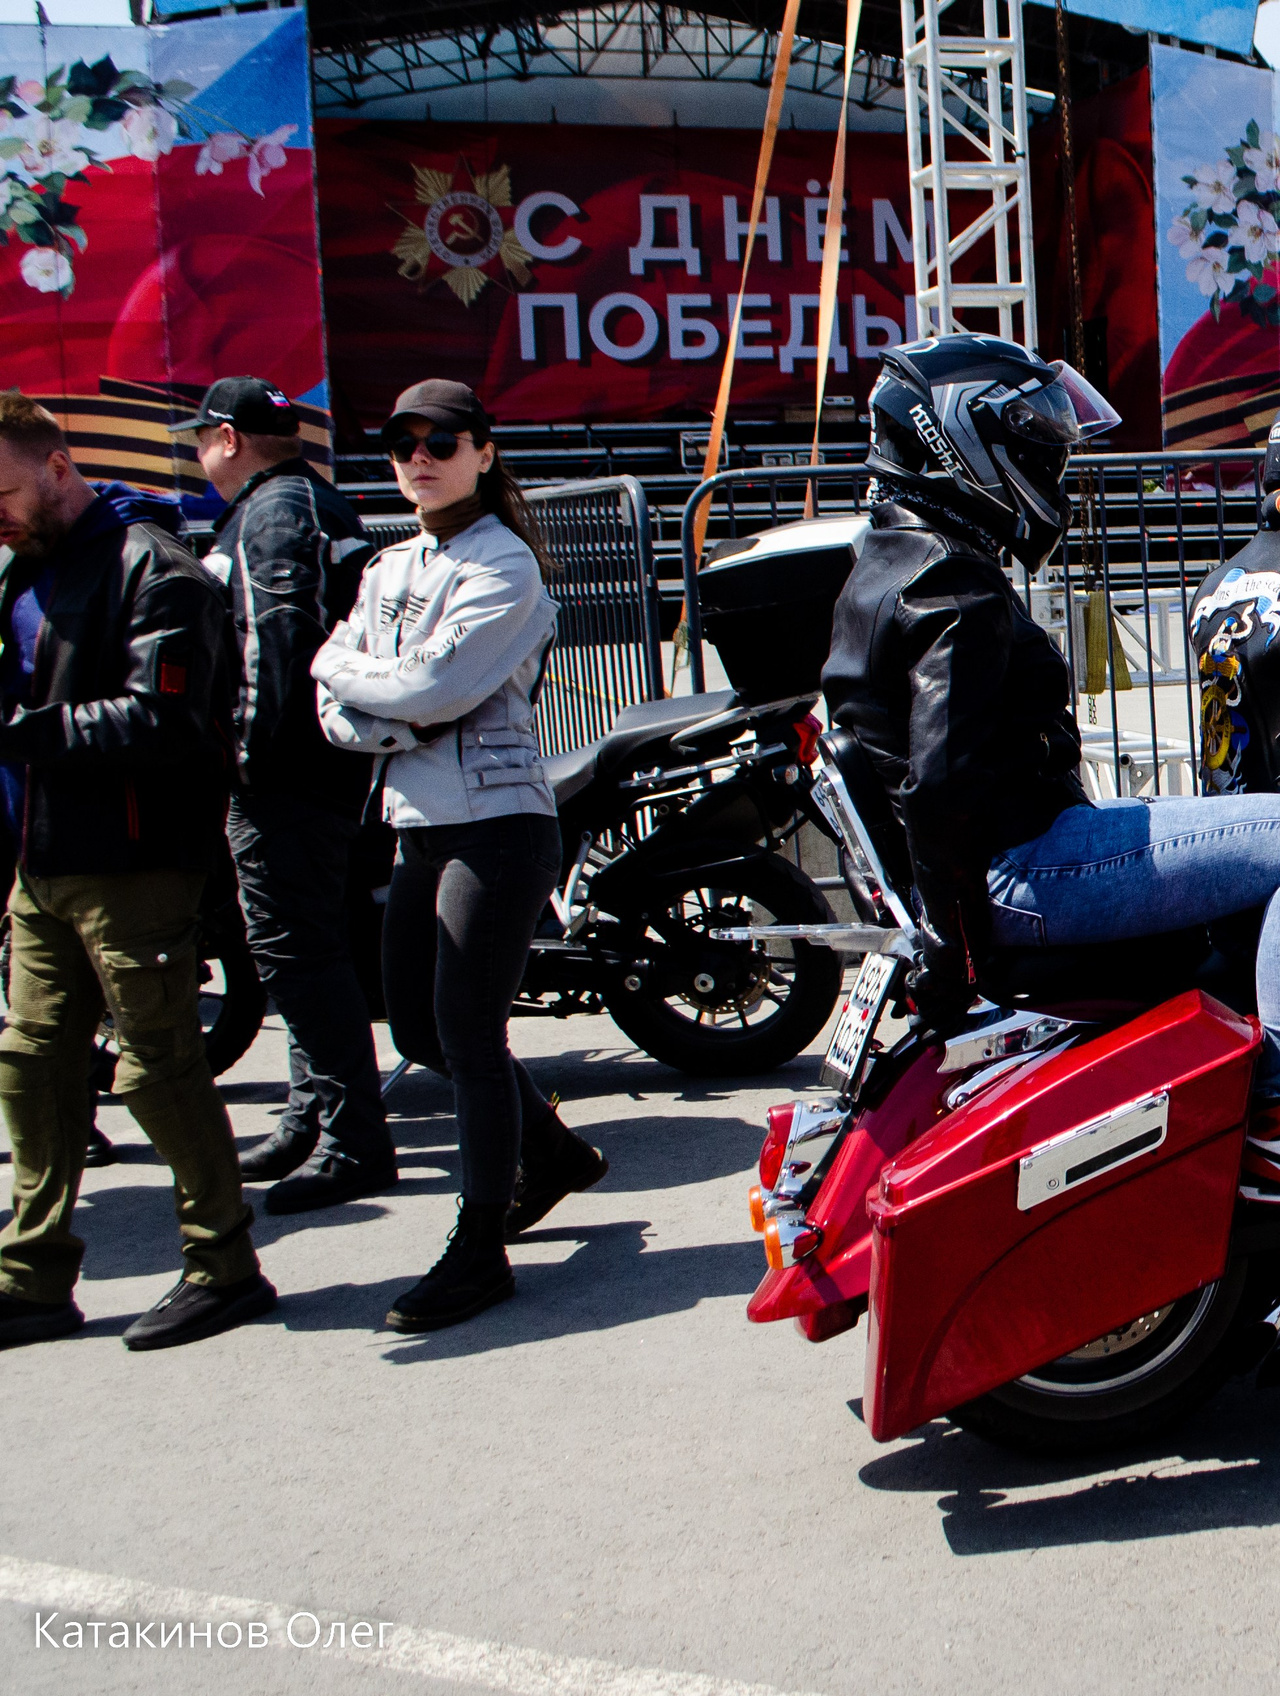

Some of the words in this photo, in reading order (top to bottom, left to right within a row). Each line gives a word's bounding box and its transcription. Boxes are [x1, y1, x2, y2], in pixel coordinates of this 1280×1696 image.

[513, 190, 582, 261] С
[629, 178, 940, 276] ДНЁМ
[517, 291, 940, 374] ПОБЕДЫ
